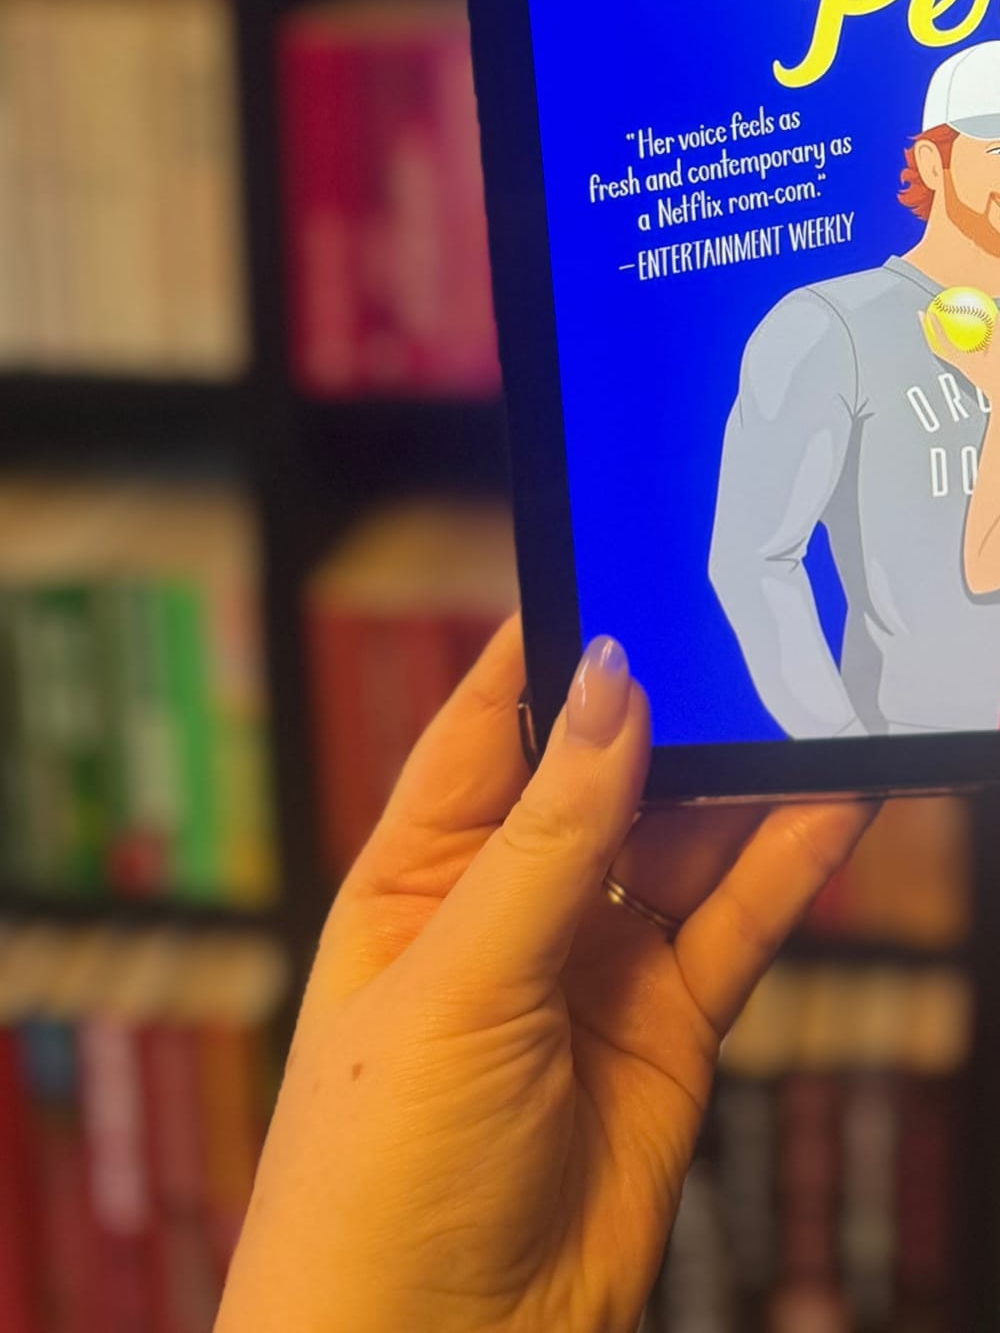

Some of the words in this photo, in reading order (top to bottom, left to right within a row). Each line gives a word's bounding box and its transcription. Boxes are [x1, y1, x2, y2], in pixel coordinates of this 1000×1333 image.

[678, 123, 728, 152] voice
[729, 105, 775, 141] feels
[778, 110, 801, 131] as
[589, 165, 640, 204] fresh
[645, 158, 683, 192] and
[687, 141, 826, 180] contemporary
[830, 135, 853, 155] as
[637, 213, 651, 232] a
[657, 189, 723, 228] Netflix
[787, 211, 855, 253] WEEKLY
